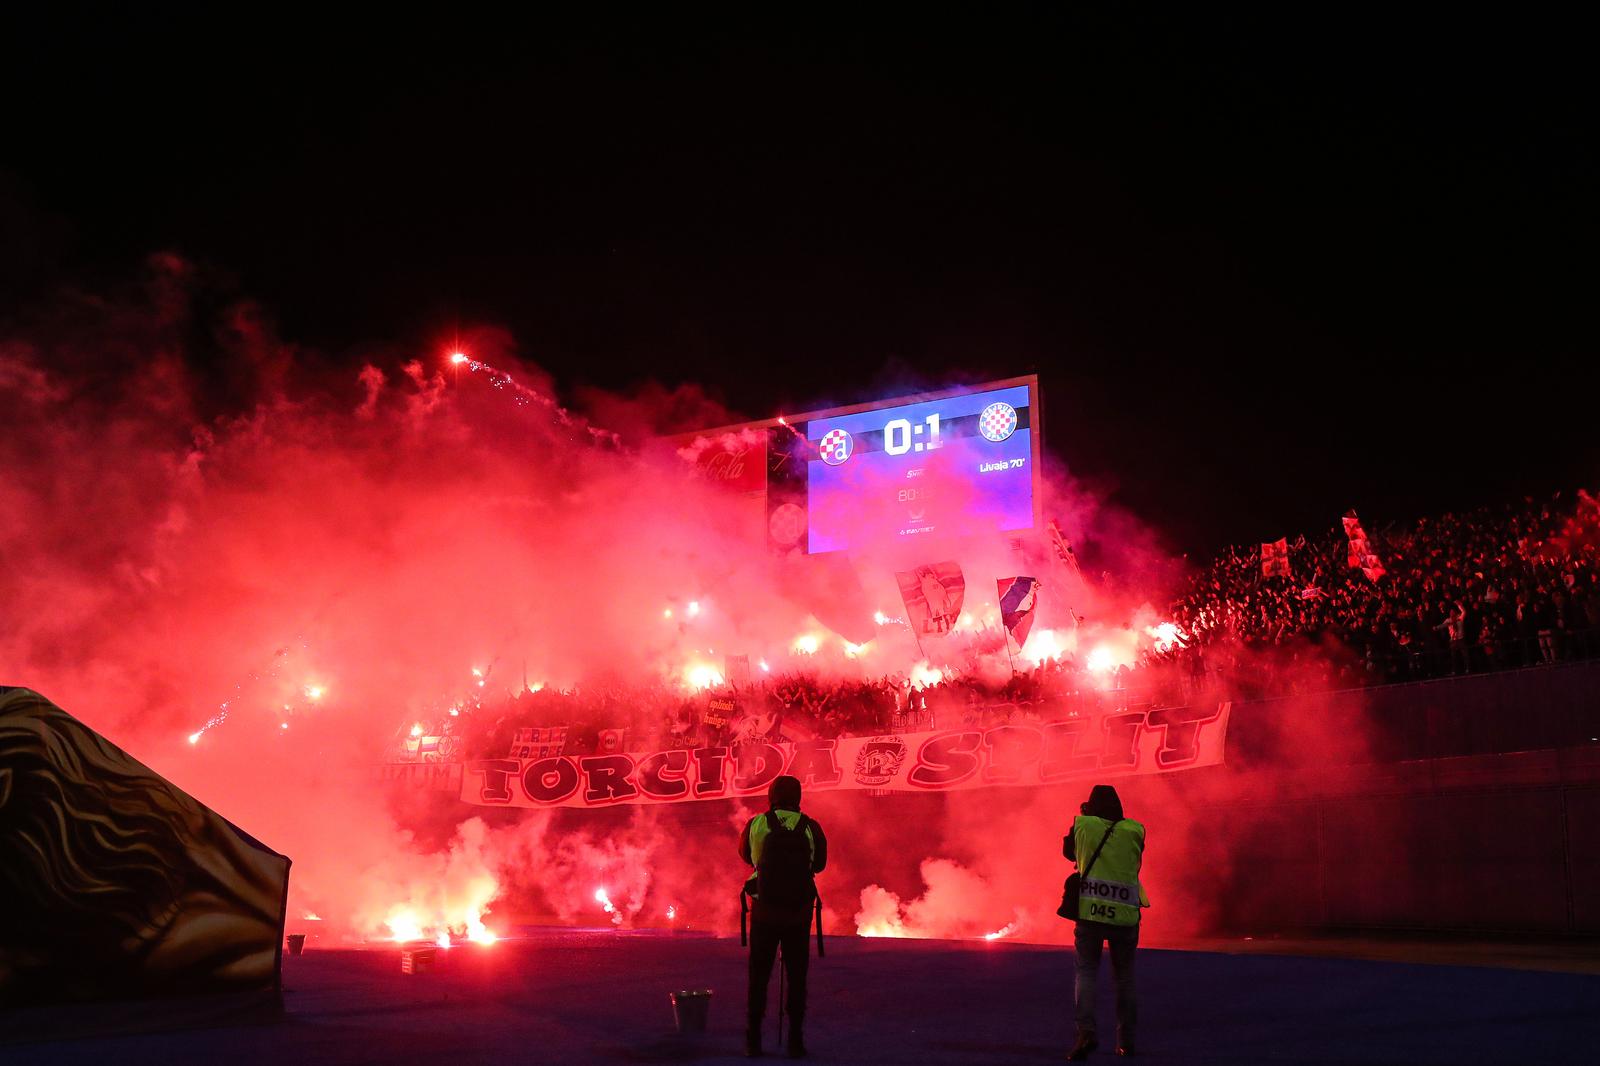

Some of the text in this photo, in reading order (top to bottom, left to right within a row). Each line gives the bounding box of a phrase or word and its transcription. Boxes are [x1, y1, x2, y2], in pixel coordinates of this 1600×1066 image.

[884, 413, 943, 456] 0:1
[980, 461, 1008, 473] Livaja
[472, 702, 1229, 804] TORCIDA SPLIT
[1080, 881, 1130, 900] PHOTO
[1090, 903, 1116, 919] 045
